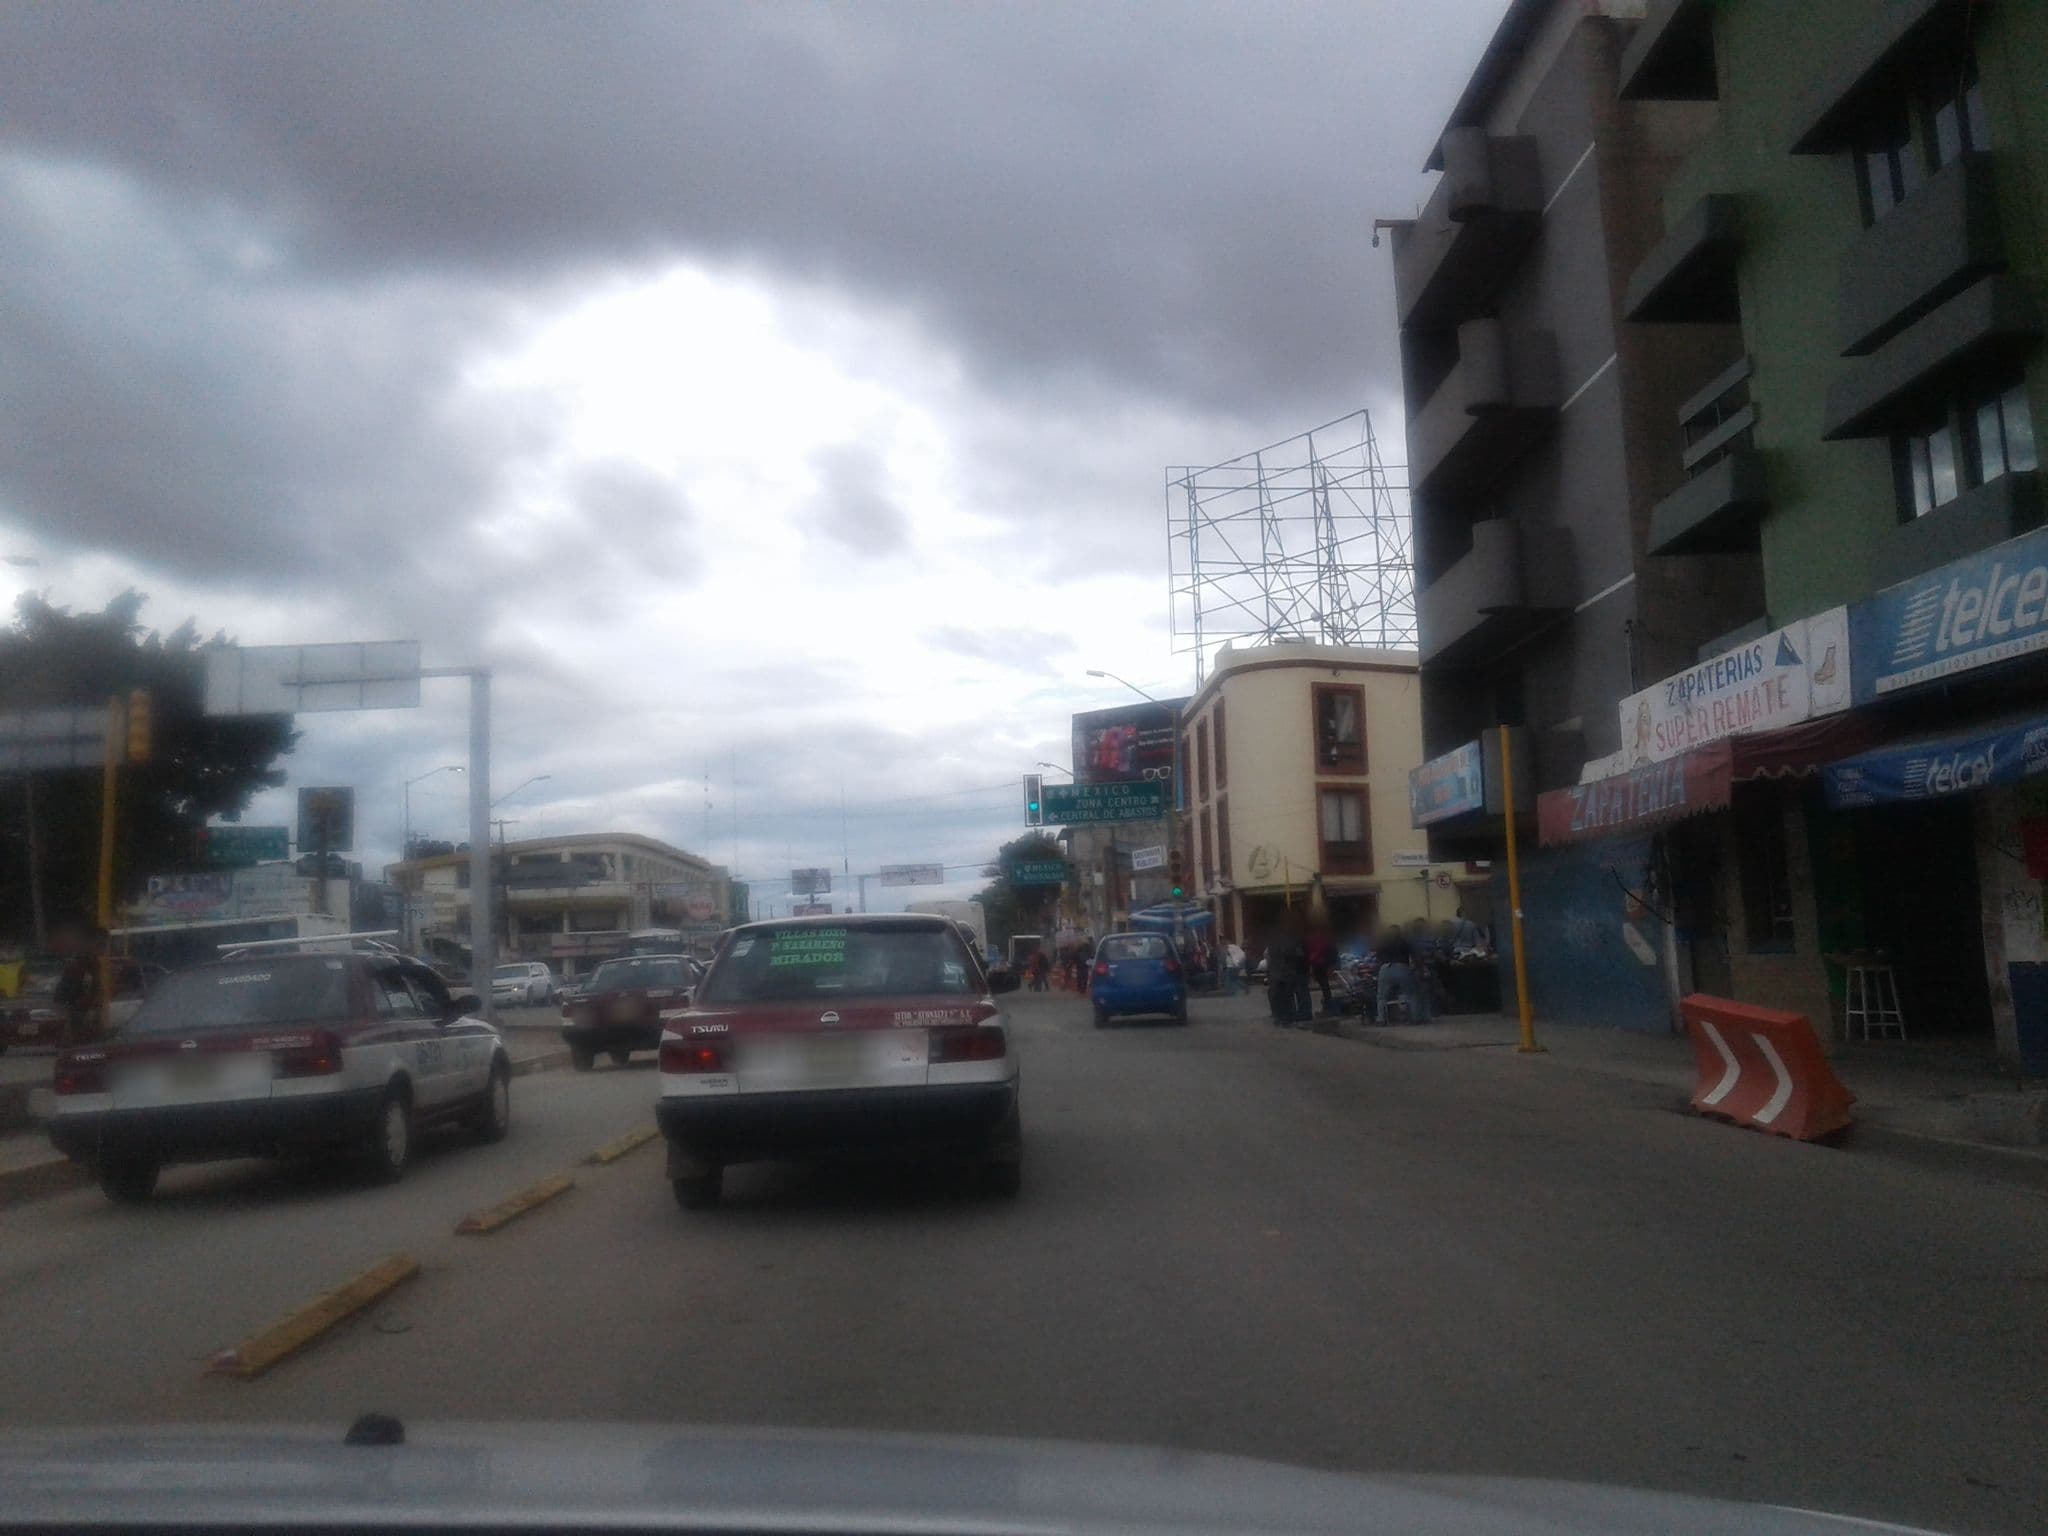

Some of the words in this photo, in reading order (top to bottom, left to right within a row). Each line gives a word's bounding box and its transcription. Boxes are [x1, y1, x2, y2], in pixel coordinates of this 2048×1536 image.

[1936, 563, 2048, 652] telce
[1665, 644, 1763, 706] ZAPATERIAS
[1656, 707, 1710, 752] SUPER
[1712, 674, 1791, 730] REMATE
[1926, 743, 1997, 796] telcel
[1076, 799, 1103, 810] ZONA
[1107, 796, 1148, 808] CENTRO
[1060, 810, 1100, 821] CENTRAL
[1103, 809, 1115, 819] DE
[775, 929, 817, 940] VILLAS
[783, 940, 845, 951] NAZARENO
[770, 952, 845, 966] MIRADOR
[691, 1024, 729, 1033] TSURU
